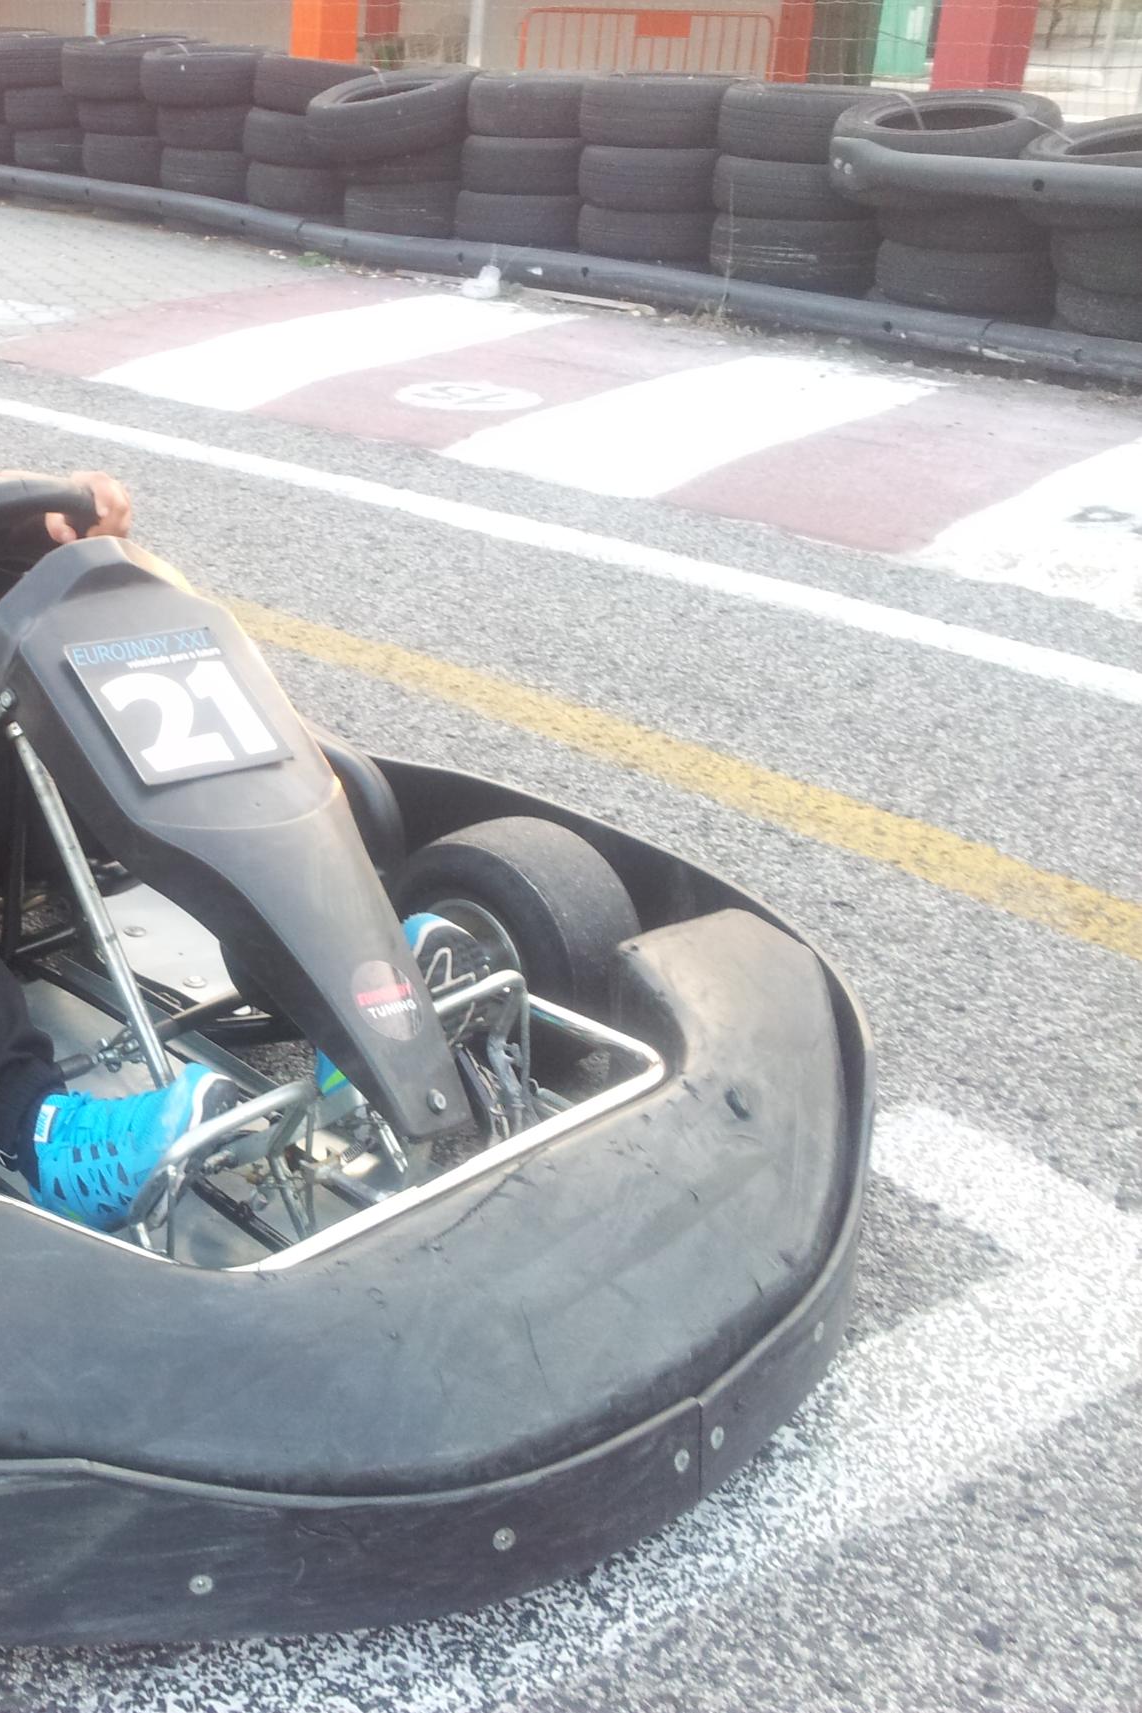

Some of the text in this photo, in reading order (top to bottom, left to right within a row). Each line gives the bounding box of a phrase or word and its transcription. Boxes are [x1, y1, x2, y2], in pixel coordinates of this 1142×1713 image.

[73, 630, 209, 667] EUROINDY XXI
[100, 660, 278, 772] 21
[367, 998, 417, 1019] TUNING
